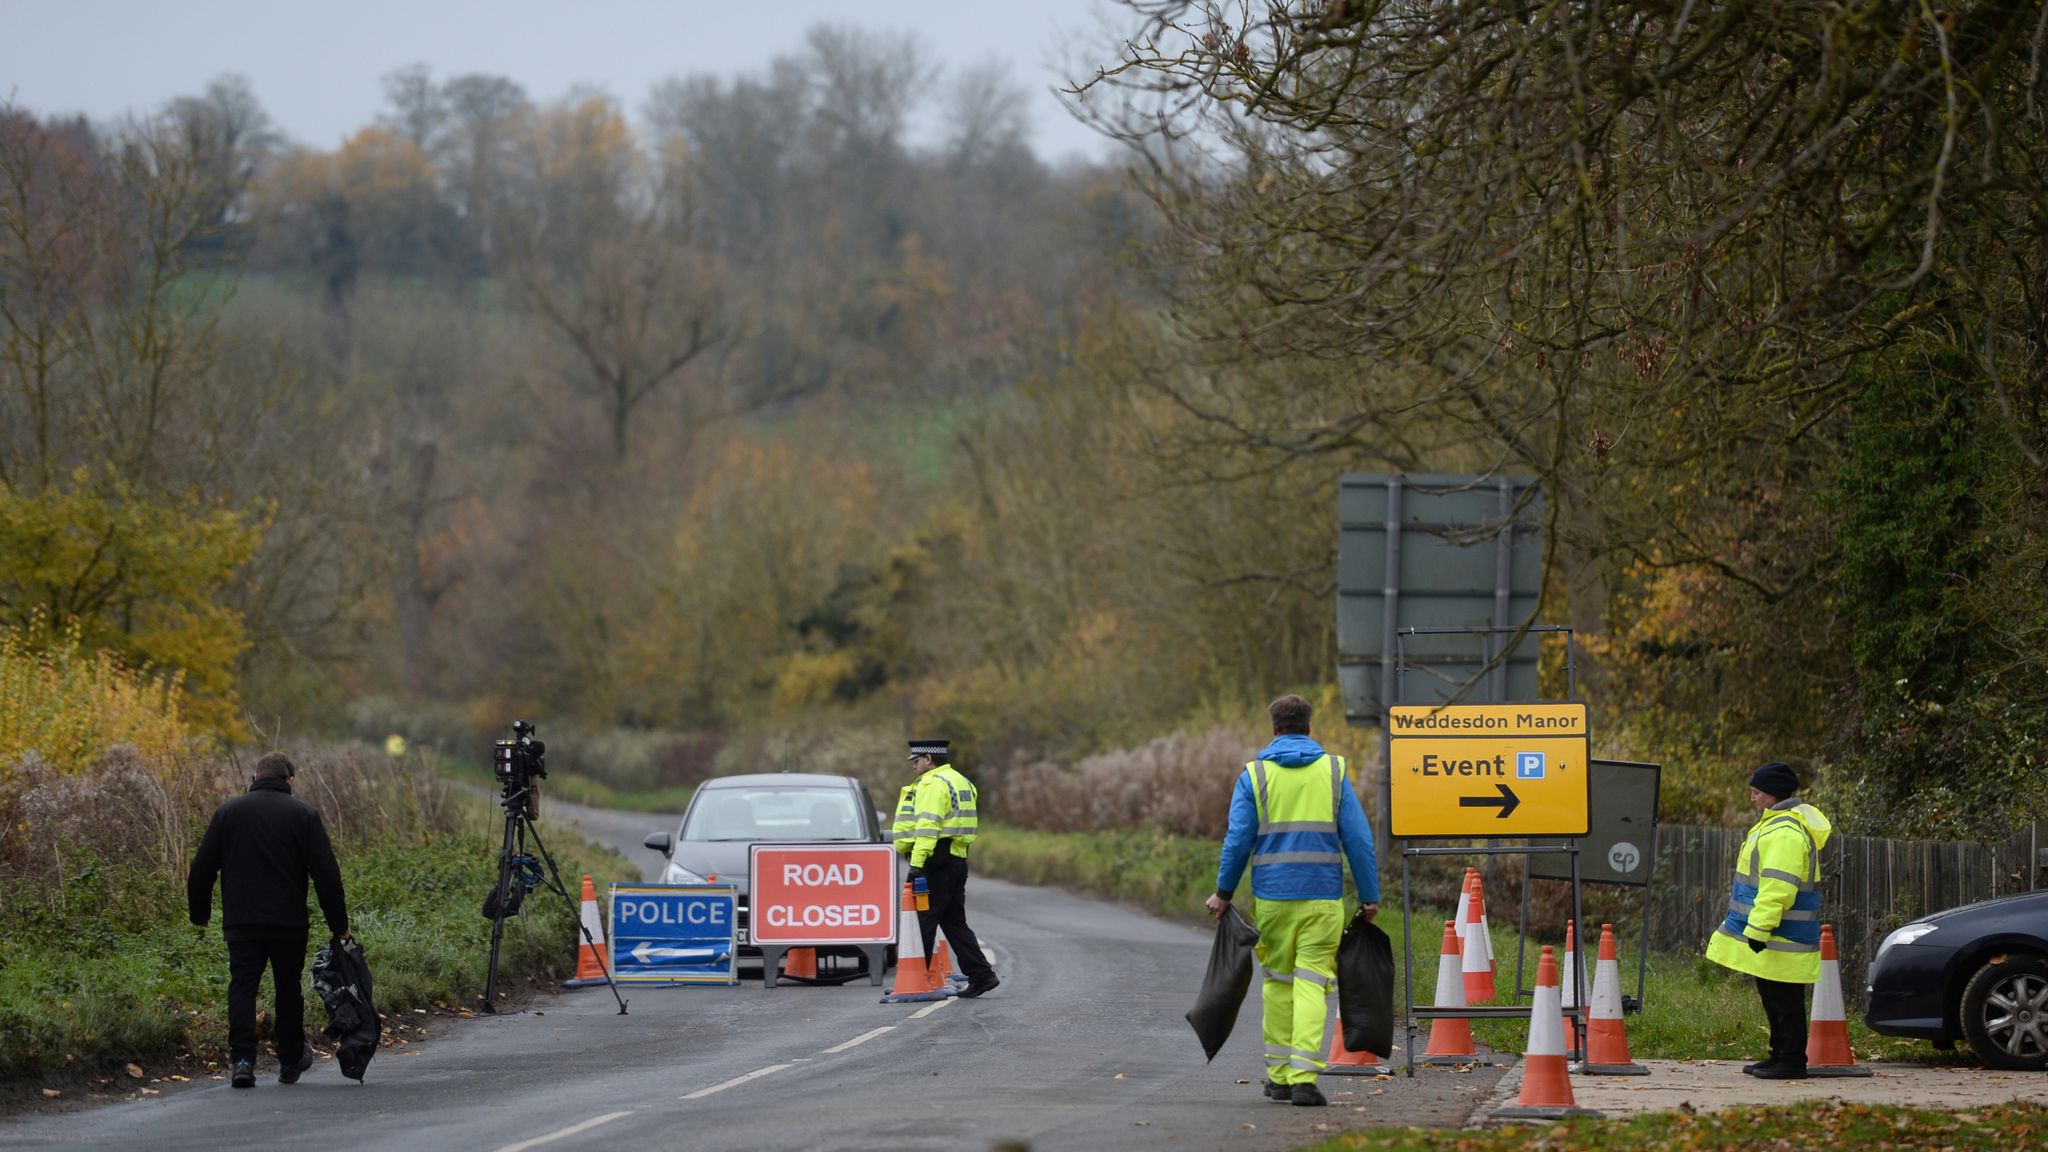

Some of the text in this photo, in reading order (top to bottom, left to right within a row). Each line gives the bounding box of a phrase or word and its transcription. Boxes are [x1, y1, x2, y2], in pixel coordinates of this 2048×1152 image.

[1395, 713, 1578, 729] Waddesdon Manor
[1422, 754, 1540, 776] Event P
[783, 863, 864, 886] ROAD
[621, 901, 725, 924] POLICE
[766, 904, 881, 927] CLOSED
